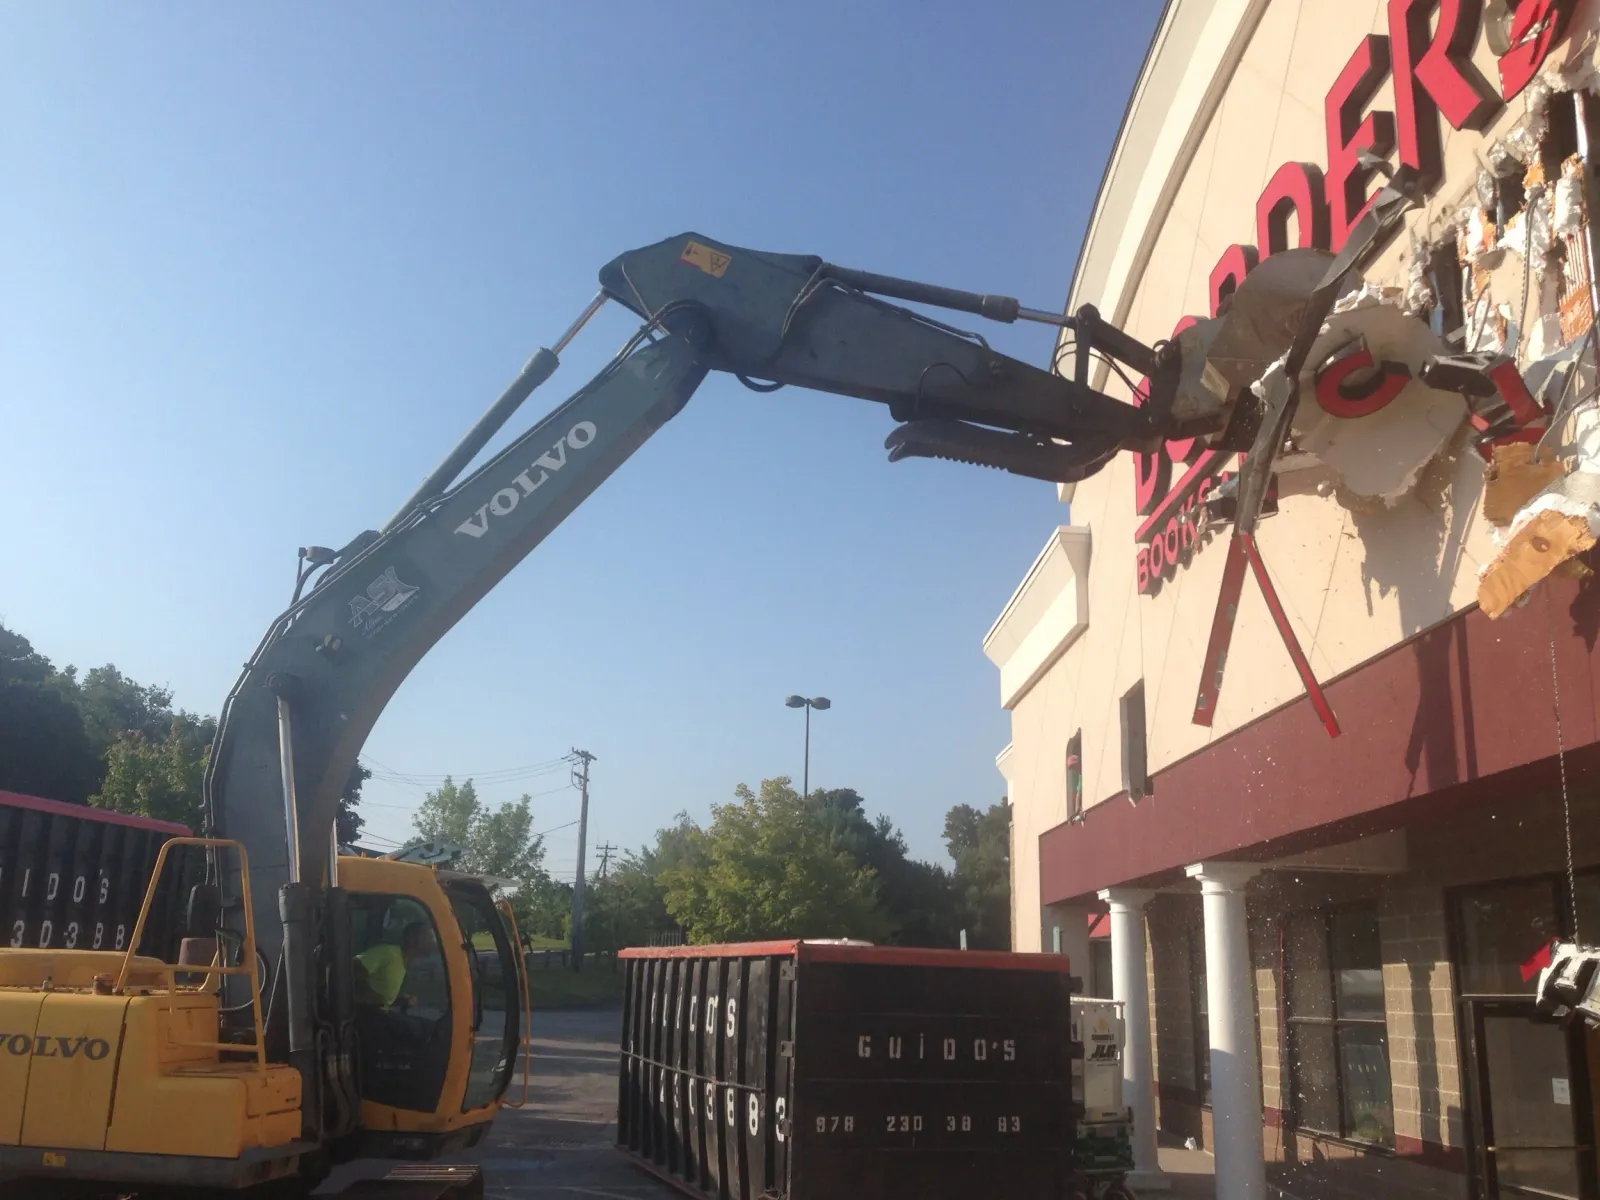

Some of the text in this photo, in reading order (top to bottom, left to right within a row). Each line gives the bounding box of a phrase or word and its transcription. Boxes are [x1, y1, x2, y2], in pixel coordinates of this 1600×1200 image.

[453, 420, 597, 538] VOLVO
[0, 867, 109, 904] IDO'S
[816, 1115, 854, 1132] 978
[886, 1115, 922, 1132] 230
